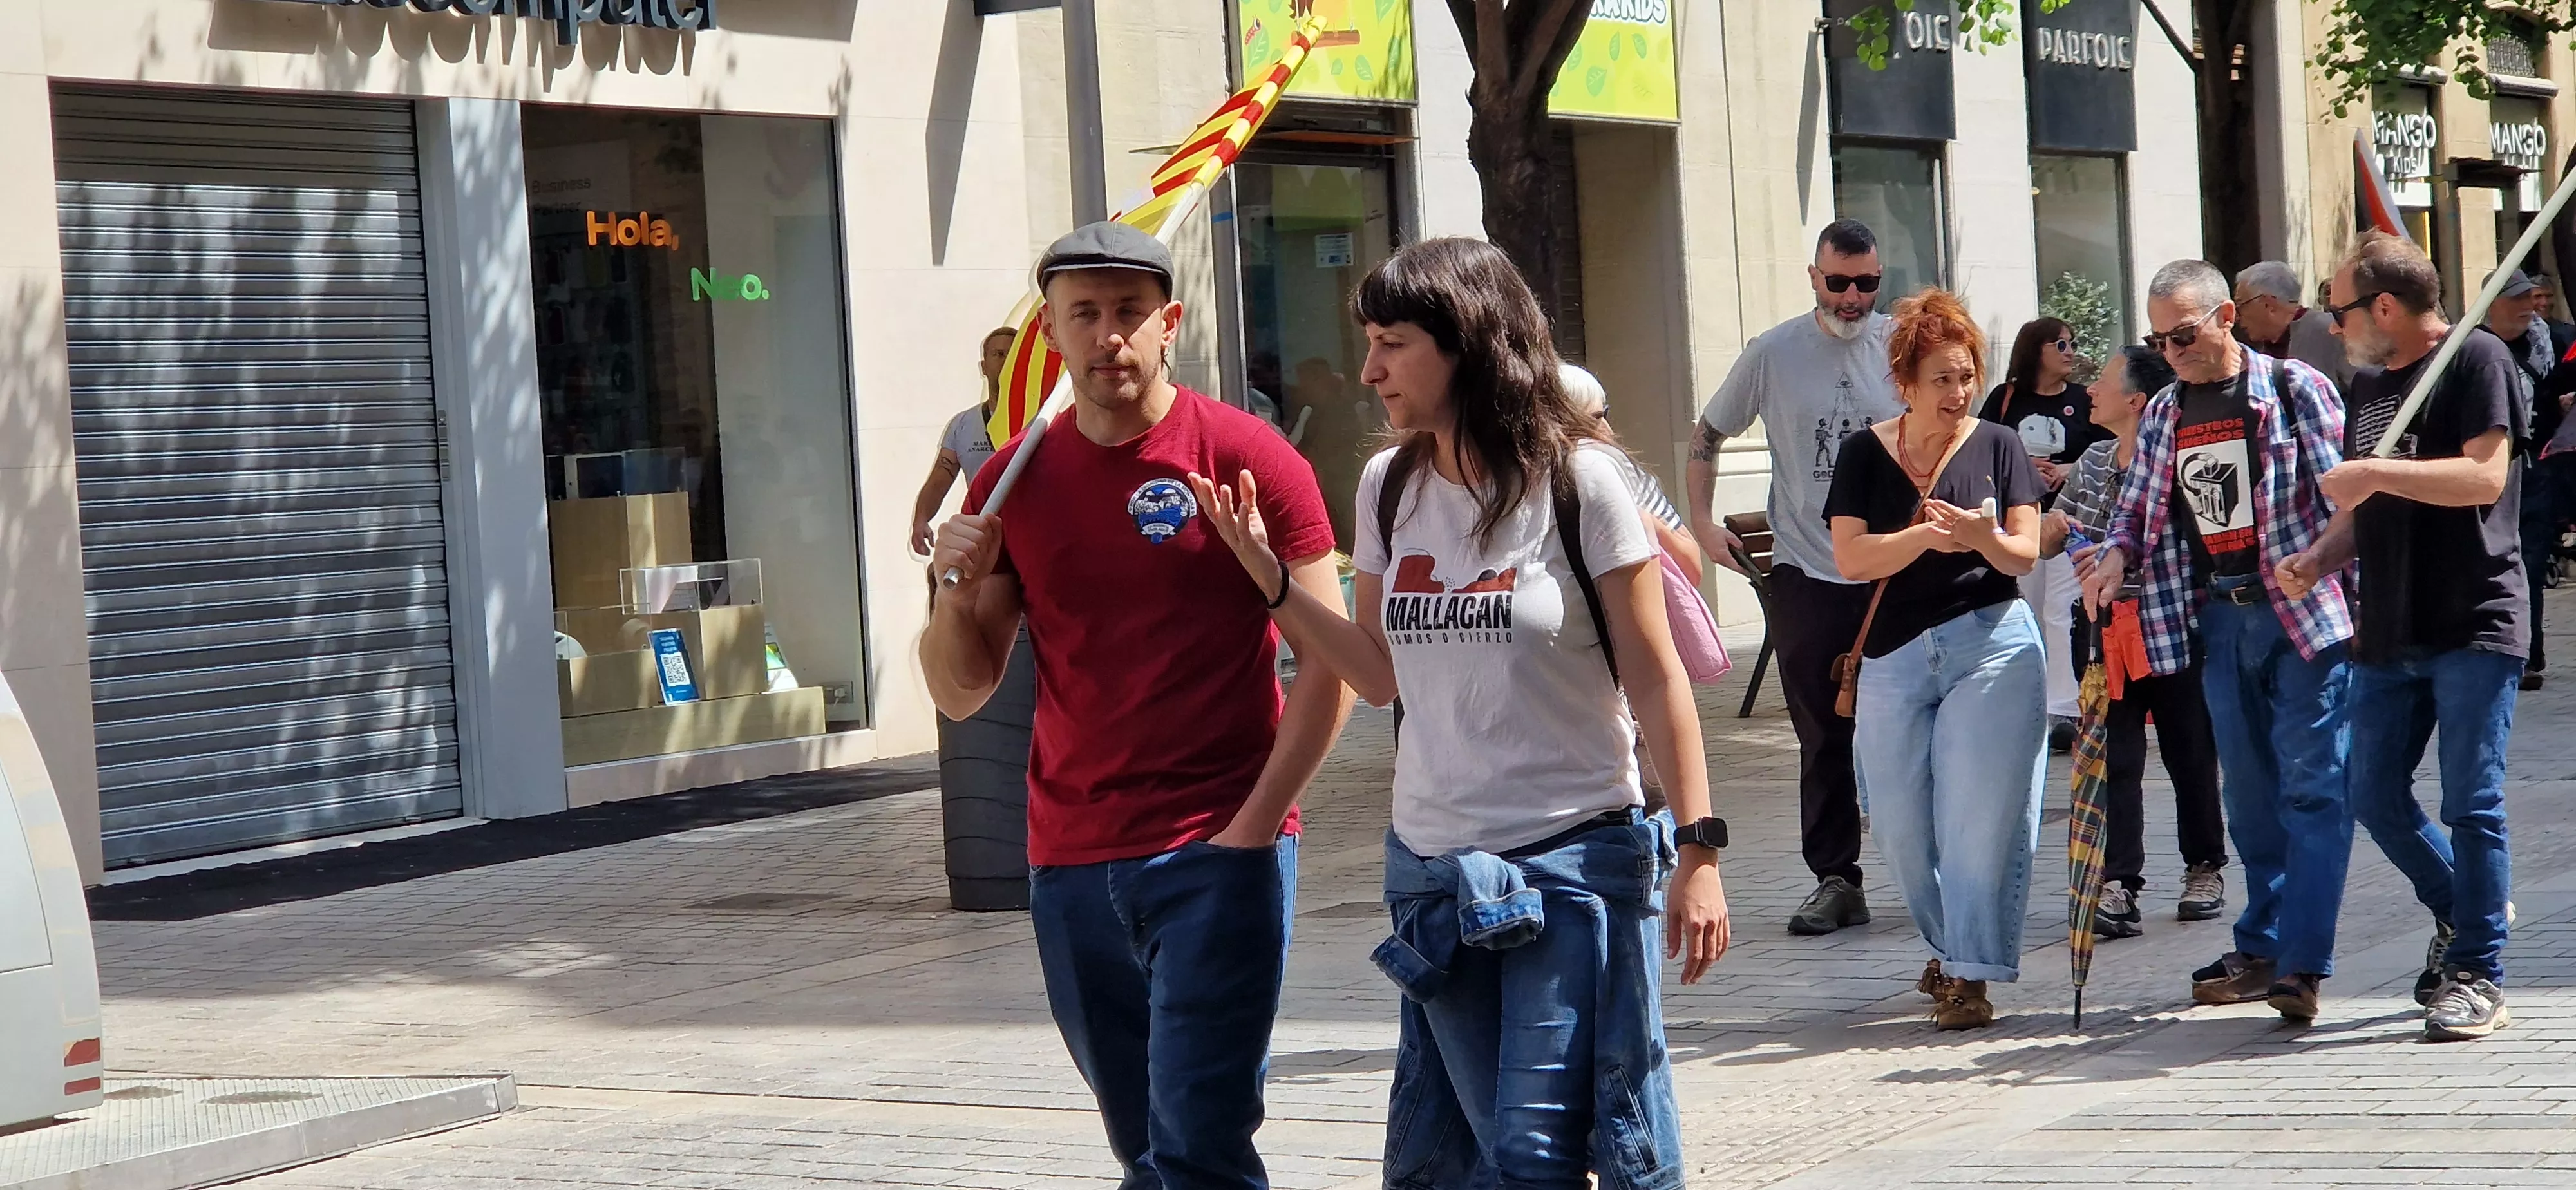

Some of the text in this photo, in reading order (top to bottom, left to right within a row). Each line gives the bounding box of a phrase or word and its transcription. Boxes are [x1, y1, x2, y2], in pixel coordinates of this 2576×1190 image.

[2372, 110, 2437, 148] MANGO
[2489, 122, 2546, 156] MANGO
[2394, 156, 2417, 174] KIDS
[586, 211, 679, 251] Hola,
[691, 267, 770, 301] Neo.
[1386, 594, 1513, 632] MALLACAN
[1388, 632, 1513, 645] SOMOS O CIERZO
